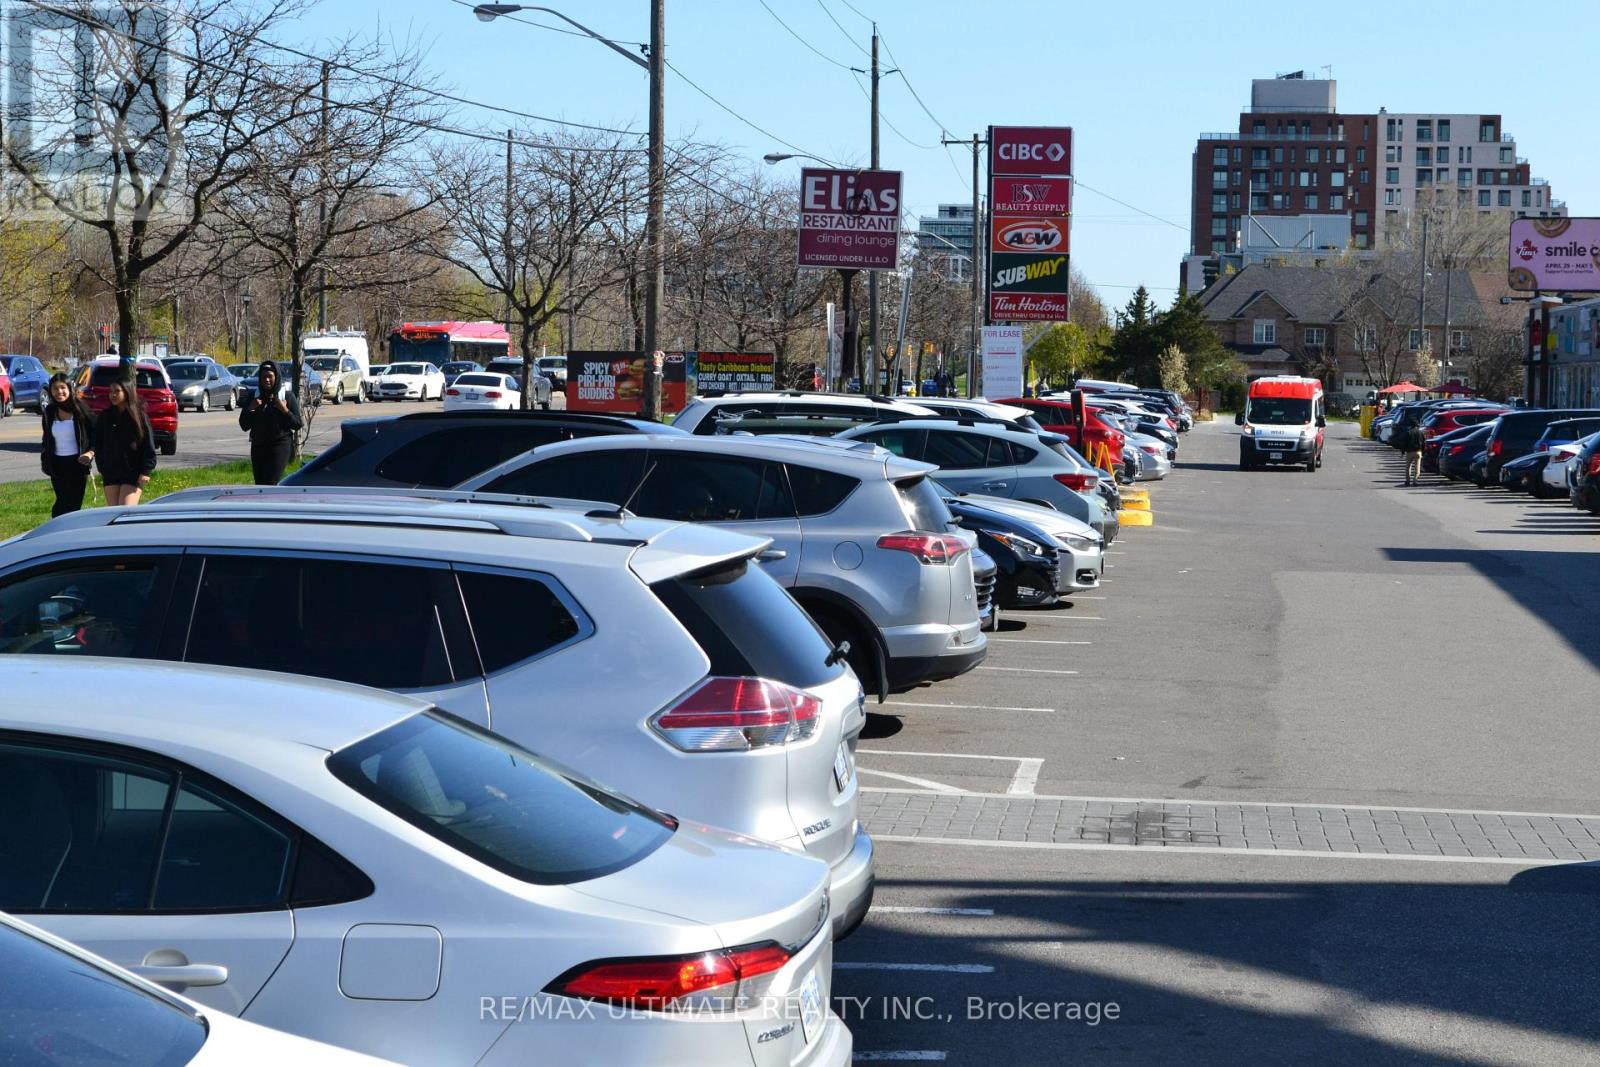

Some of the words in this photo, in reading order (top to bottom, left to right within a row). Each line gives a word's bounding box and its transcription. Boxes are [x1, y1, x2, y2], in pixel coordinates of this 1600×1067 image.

[998, 143, 1043, 160] CIBC
[1011, 184, 1051, 202] BSW
[996, 203, 1030, 211] BEAUTY
[803, 214, 897, 230] RESTAURANT
[816, 233, 852, 246] dining
[855, 234, 895, 247] lounge
[1009, 232, 1057, 245] A&W
[1546, 242, 1586, 256] smile
[805, 253, 837, 262] LICENSED
[839, 255, 864, 263] UNDER
[993, 256, 1066, 288] SUBWAY
[994, 297, 1015, 310] Tim
[1018, 297, 1065, 311] Hortons
[584, 362, 609, 374] SPICY
[699, 362, 716, 372] Tasty
[578, 374, 615, 387] PIRI-PIRI
[698, 373, 717, 381] CURRY
[718, 373, 732, 381] GOAT
[578, 387, 615, 400] BUDDIES
